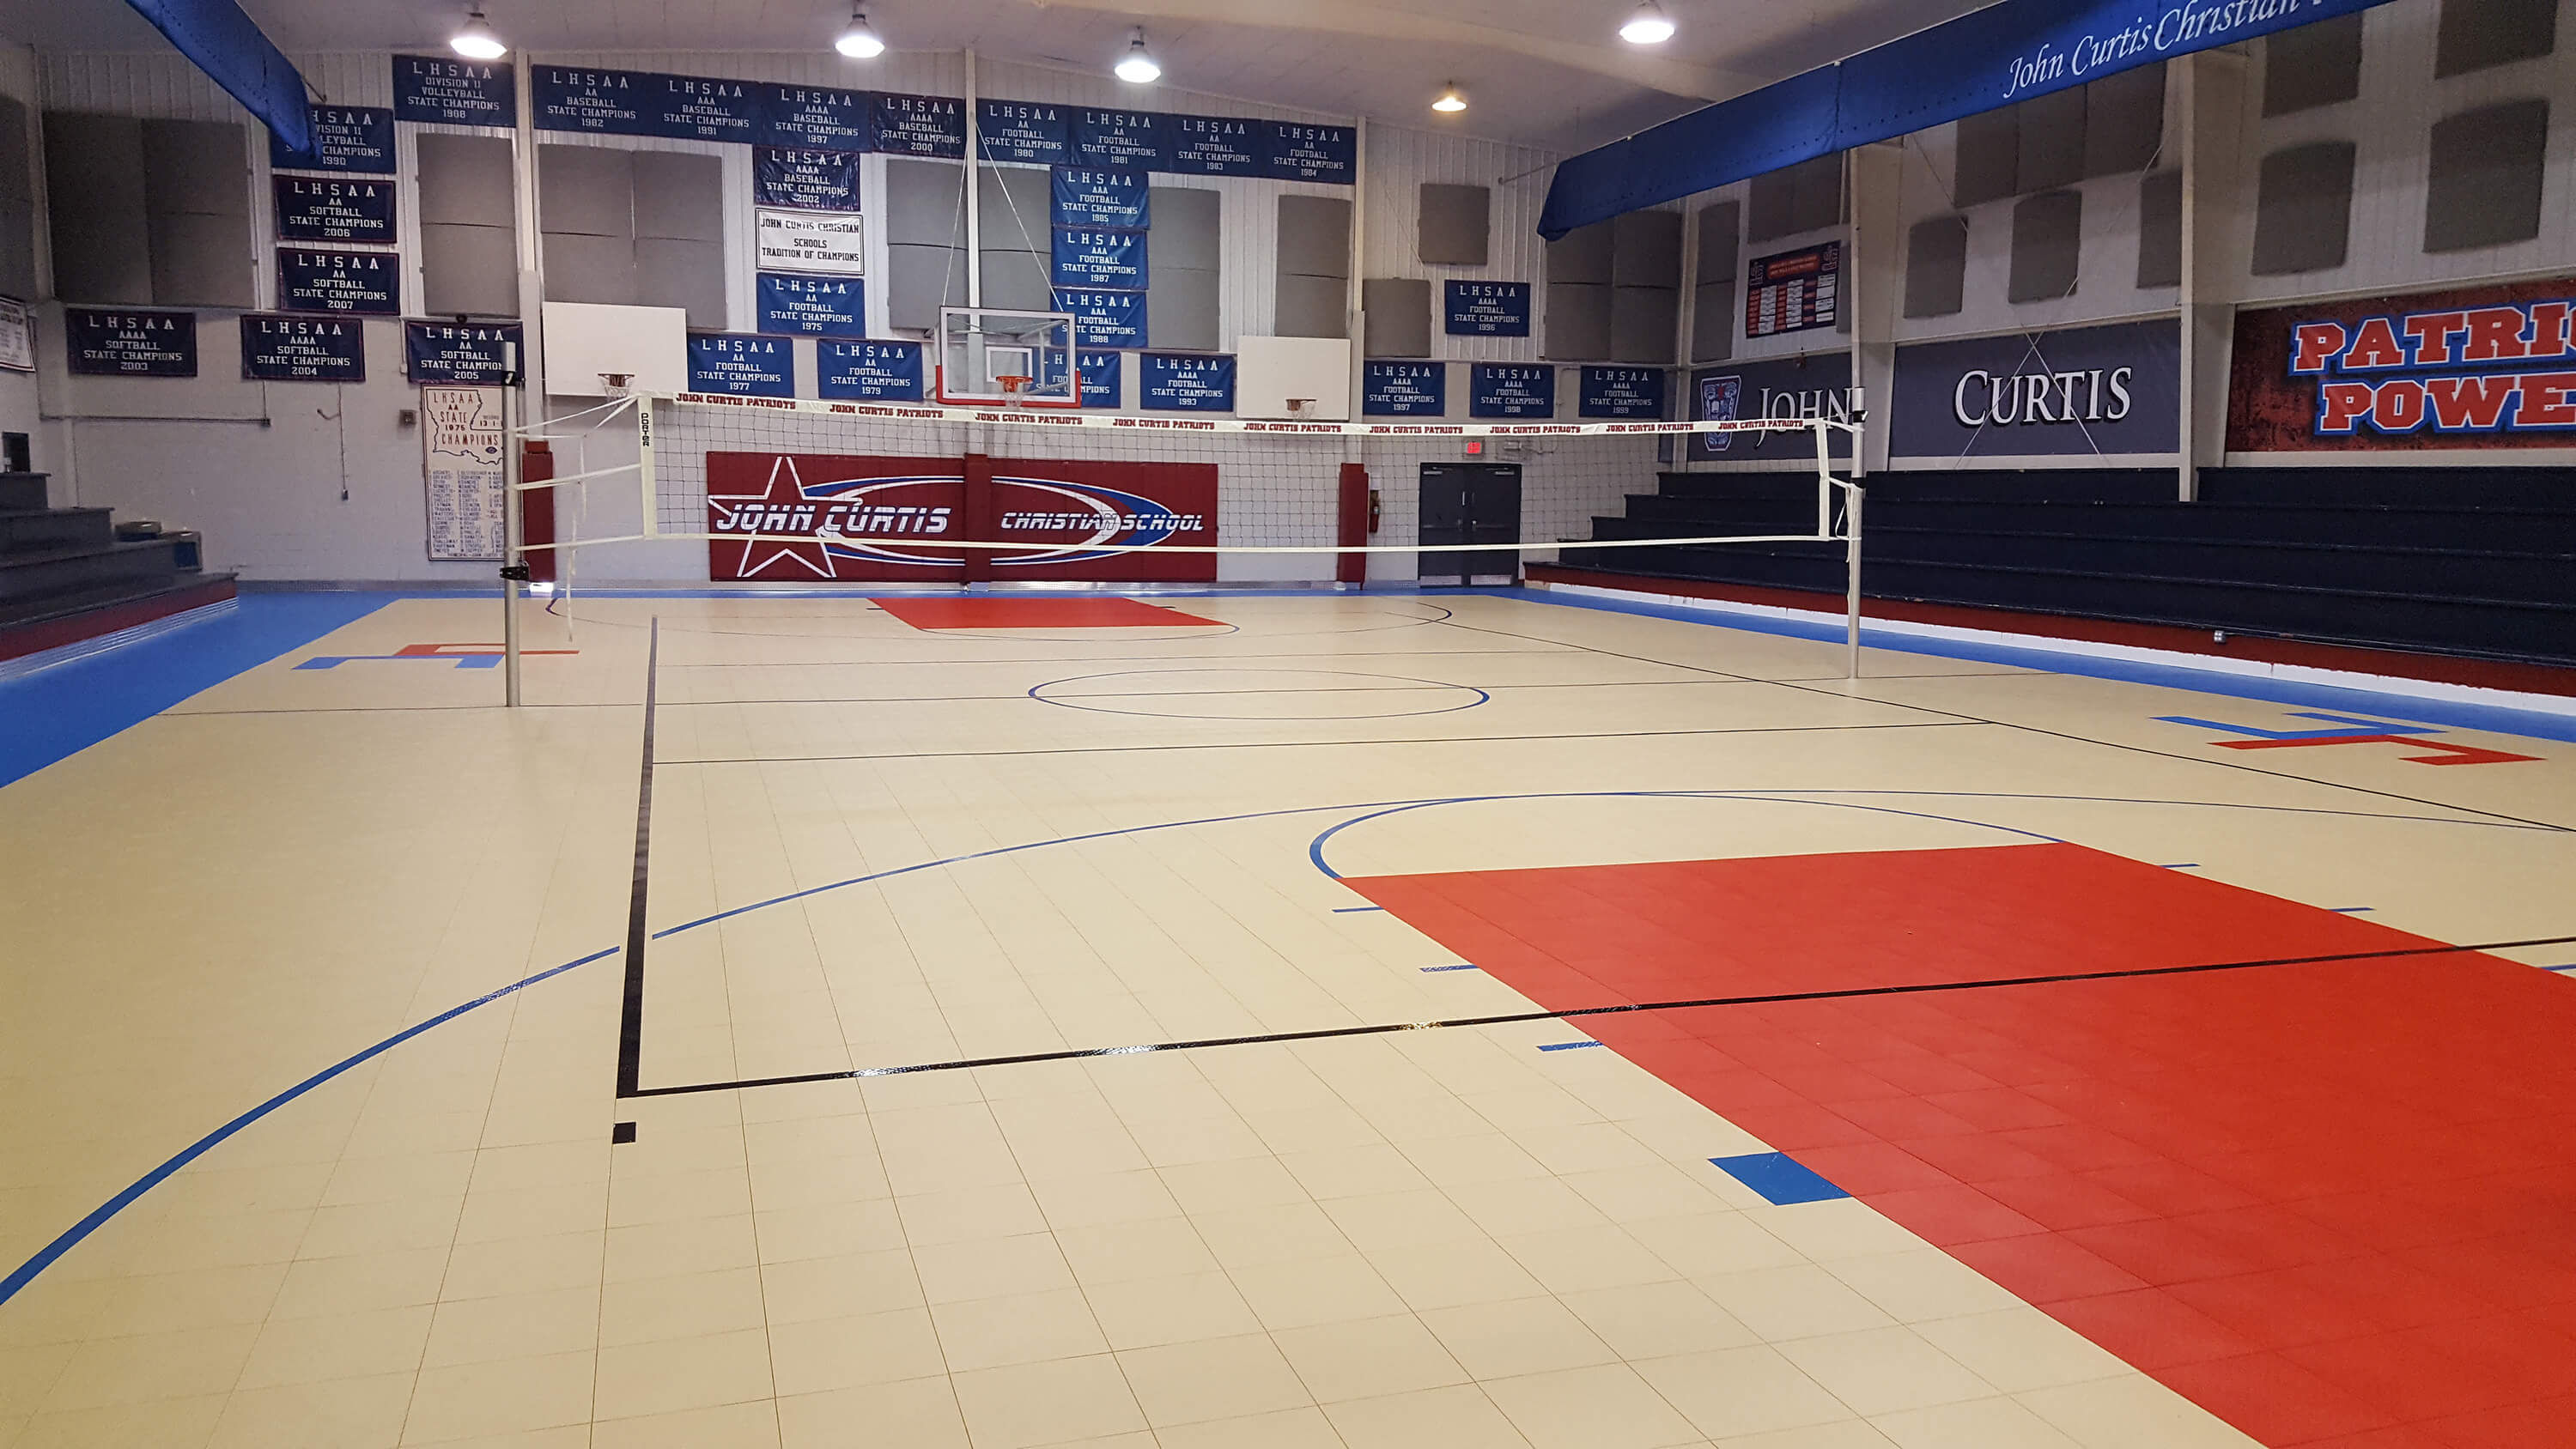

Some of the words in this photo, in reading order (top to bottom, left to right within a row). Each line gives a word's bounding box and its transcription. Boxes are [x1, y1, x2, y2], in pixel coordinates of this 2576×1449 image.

[2003, 43, 2064, 99] John
[2071, 16, 2153, 76] Curtis
[425, 76, 468, 87] DIVISION
[422, 87, 484, 99] VOLLEYBALL
[408, 96, 437, 106] STATE
[443, 99, 499, 110] CHAMPIONS
[567, 96, 616, 107] BASEBALL
[547, 105, 576, 114] STATE
[581, 107, 635, 118] CHAMPIONS
[682, 105, 730, 115] BASEBALL
[664, 113, 691, 123] STATE
[696, 116, 749, 127] CHAMPIONS
[793, 113, 840, 124] BASEBALL
[697, 126, 716, 135] 1991
[775, 122, 802, 131] STATE
[807, 124, 858, 136] CHAMPIONS
[899, 122, 943, 131] BASEBALL
[807, 134, 827, 143] 1997
[882, 130, 907, 139] STATE
[912, 132, 960, 143] CHAMPIONS
[1002, 129, 1043, 138] FOOTBALL
[984, 137, 1010, 146] STATE
[1014, 139, 1061, 149] CHAMPIONS
[1098, 136, 1139, 145] FOOTBALL
[323, 145, 381, 157] CHAMPIONS
[910, 142, 932, 151] 2000
[1081, 143, 1106, 152] STATE
[1110, 145, 1155, 156] CHAMPIONS
[1194, 142, 1233, 152] FOOTBALL
[1111, 155, 1127, 164] 1981
[1178, 151, 1201, 160] STATE
[1206, 153, 1250, 162] CHAMPIONS
[1290, 149, 1327, 159] FOOTBALL
[1273, 156, 1297, 166] STATE
[1301, 159, 1343, 169] CHAMPIONS
[784, 173, 829, 184] BASEBALL
[766, 182, 793, 191] STATE
[798, 185, 848, 195] CHAMPIONS
[1079, 194, 1120, 203] FOOTBALL
[309, 206, 361, 216] SOFTBALL
[1062, 203, 1086, 211] STATE
[1091, 204, 1138, 215] CHAMPIONS
[289, 215, 319, 225] STATE
[325, 218, 383, 227] CHAMPIONS
[761, 218, 781, 228] JOHN
[818, 222, 860, 233] CHRISTIAN
[793, 238, 828, 248] SCHOOLS
[762, 247, 801, 258] TRADITION
[805, 251, 814, 259] OF
[817, 251, 860, 262] CHAMPIONS
[1079, 255, 1119, 264] FOOTBALL
[1091, 264, 1136, 274] CHAMPIONS
[313, 279, 364, 288] SOFTBALL
[1091, 274, 1109, 282] 1987
[293, 288, 323, 297] STATE
[329, 289, 386, 300] CHAMPIONS
[327, 300, 353, 309] 2007
[789, 302, 833, 312] FOOTBALL
[770, 311, 797, 319] STATE
[802, 312, 852, 323] CHAMPIONS
[1078, 316, 1118, 324] FOOTBALL
[802, 322, 822, 330] 1975
[1090, 325, 1135, 334] CHAMPIONS
[106, 340, 159, 349] SOFTBALL
[84, 350, 116, 359] STATE
[122, 351, 181, 361] CHAMPIONS
[276, 346, 328, 355] SOFTBALL
[440, 351, 489, 360] SOFTBALL
[257, 355, 287, 364] STATE
[293, 356, 349, 365] CHAMPIONS
[291, 367, 317, 375] 2004
[715, 361, 761, 371] FOOTBALL
[849, 367, 892, 376] FOOTBALL
[696, 370, 724, 379] STATE
[729, 372, 781, 382] CHAMPIONS
[676, 392, 703, 403] JOHN
[706, 395, 744, 406] CURTIS
[746, 397, 796, 409] PATRIOTS
[829, 403, 856, 414] JOHN
[859, 406, 894, 416] CURTIS
[896, 408, 944, 419] PATRIOTS
[1755, 387, 1853, 447] JOHN
[1954, 367, 2133, 427] CURTIS
[440, 411, 467, 423] STATE
[975, 412, 999, 421] JOHN
[1002, 415, 1036, 423] CURTIS
[1038, 415, 1083, 425] PATRIOTS
[641, 412, 650, 446] PORTER
[1113, 418, 1136, 427] JOHN
[1139, 420, 1170, 428] CURTIS
[1173, 420, 1215, 429] PATRIOTS
[1243, 422, 1265, 431] JOHN
[1269, 423, 1298, 433] CURTIS
[1301, 424, 1342, 433] PATRIOTS
[1718, 421, 1737, 429] JOHN
[1740, 421, 1765, 429] CURTIS
[1768, 419, 1803, 428] PATRIOTS
[441, 433, 498, 446] CHAMPIONS
[716, 504, 815, 531] JOHN
[820, 506, 952, 533] CURTIS
[1000, 512, 1118, 530] CHRISTIAN
[1120, 514, 1205, 531] SCHOOL
